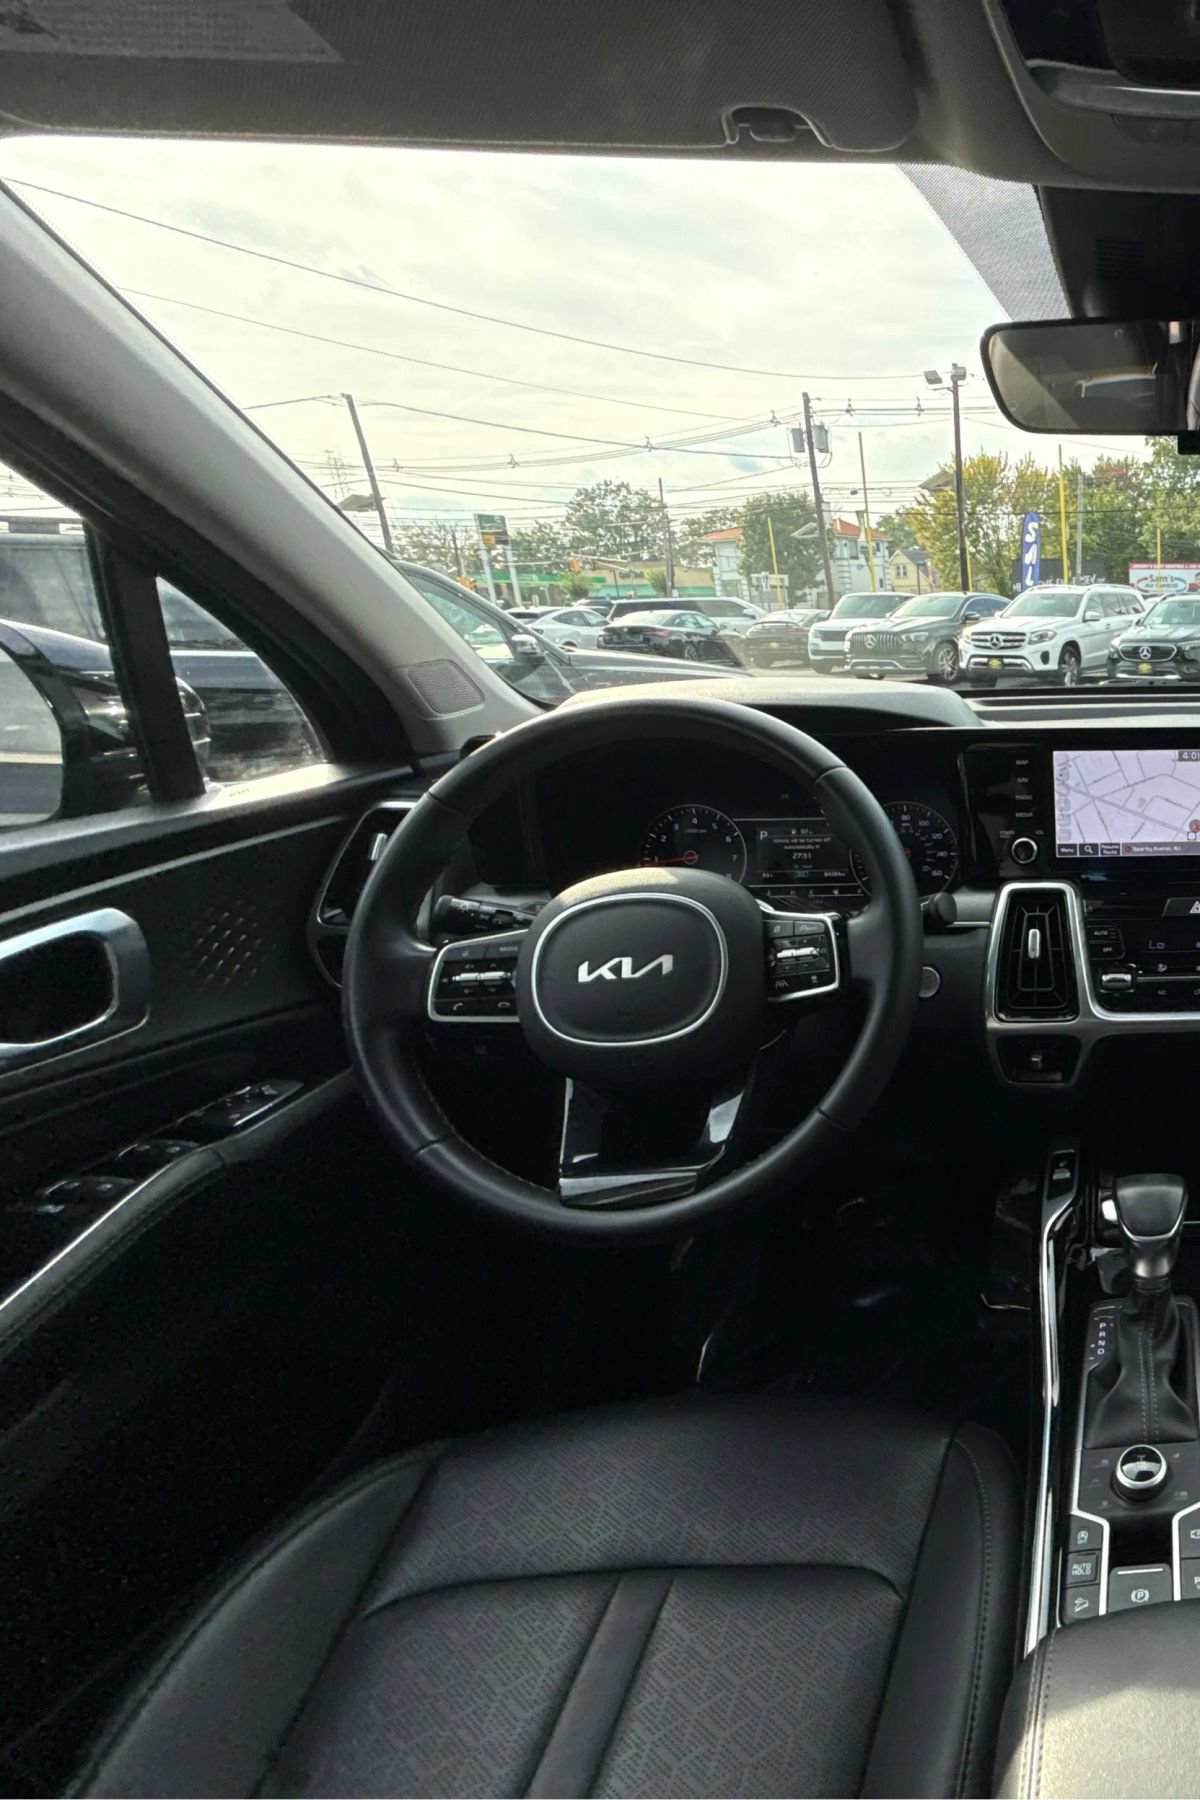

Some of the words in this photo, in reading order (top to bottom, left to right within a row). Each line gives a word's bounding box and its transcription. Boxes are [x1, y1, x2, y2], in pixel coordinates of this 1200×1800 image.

[1024, 521, 1039, 587] SAL
[1149, 573, 1175, 583] Sam's
[1181, 751, 1200, 760] 4:01
[760, 830, 768, 841] P
[931, 832, 943, 840] 120
[931, 869, 943, 877] 160
[1149, 939, 1166, 949] Lo
[578, 954, 673, 982] KIA
[1072, 1562, 1092, 1570] AUTO
[1071, 1568, 1092, 1576] HOLD
